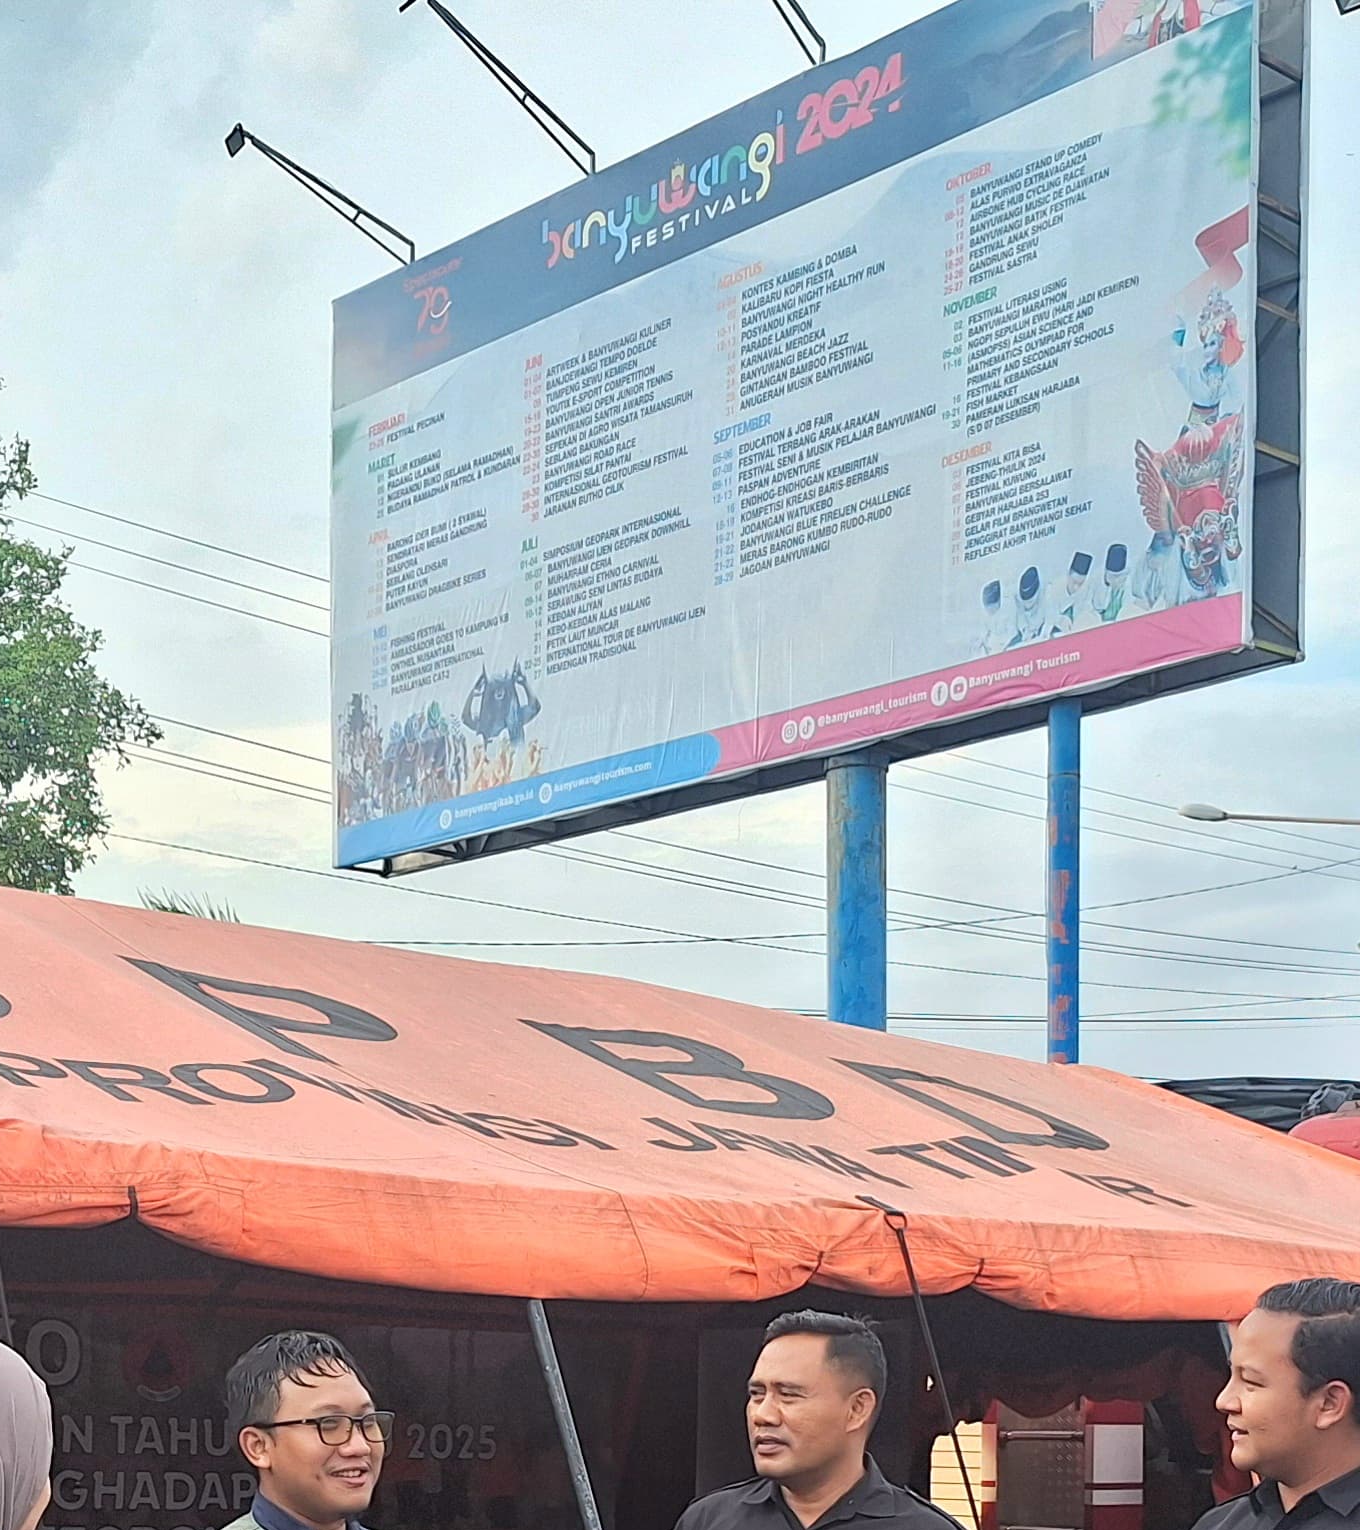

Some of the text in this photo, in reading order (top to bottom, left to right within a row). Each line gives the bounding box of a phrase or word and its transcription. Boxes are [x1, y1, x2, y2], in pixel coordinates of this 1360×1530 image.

[795, 52, 910, 154] 2024
[969, 131, 1102, 199] BANYUWANGI STAND UP COMEDY
[969, 193, 990, 211] ALAS
[1023, 151, 1087, 188] EXTRAVAGANZA
[1006, 191, 1024, 208] HUB
[1025, 175, 1061, 200] CYCLING
[1062, 164, 1085, 184] RACE
[630, 188, 751, 255] FESTIVAL
[969, 167, 1110, 236] BANYUWANGI MUSIC DE DJAWATAN
[969, 189, 1087, 249] BANYUWANGI BATIK FESTIVAL
[968, 235, 1039, 274] GANDRUNG SEWU
[969, 212, 1064, 261] FESTIVAL ANAK SHOLEH
[741, 277, 774, 301] KONTES
[775, 260, 815, 287] KAMBING
[824, 242, 857, 266] DOMBA
[741, 266, 834, 315] KALIBARU KOPI FIESTA
[968, 248, 1037, 286] FESTIVAL SASTRA
[741, 260, 885, 329] BANYUWANGI NIGHT HEALTHY RUN
[943, 285, 997, 317] NOVEMBER
[967, 276, 1067, 326] FESTIVAL LITERASI USING
[967, 289, 1067, 338] BANYUWANGI MARATHON
[740, 317, 813, 356] PARADE LAMPION
[741, 300, 821, 343] POSYANDU KREATIF
[967, 331, 993, 350] NGOPI
[994, 316, 1030, 340] SEPULUH
[1031, 308, 1050, 326] EWU
[1051, 299, 1074, 318] (HARI
[1075, 291, 1095, 309] JADI
[1012, 326, 1037, 346] ASIAN
[1038, 312, 1074, 336] SCIENCE
[1075, 304, 1093, 322] AND
[740, 326, 825, 370] KARNAVAL MERDEKA
[740, 331, 849, 384] BANYUWANGI BEACH JAZZ
[740, 338, 868, 397] GINTANGAN BAMBOO FESTIVAL
[966, 322, 1114, 387] PRIMARY AND SECONDARY SCHOOLS
[967, 320, 1084, 375] MATHEMATICS OLYMPIAD FOR
[739, 350, 873, 411] ANUGERAH MUSIK BANYUWANGI
[966, 356, 1058, 400] FESTIVAL KEBANGSAAN
[966, 384, 1018, 412] FISH MARKET
[713, 411, 771, 445] SEPTEMBER
[738, 428, 785, 456] EDUCATION
[794, 419, 811, 435] JOB
[813, 411, 833, 429] FAIR
[966, 402, 1003, 424] PAMERAN
[738, 459, 775, 483] FESTIVAL
[776, 452, 796, 469] SENI
[806, 439, 833, 459] MUSIK
[835, 424, 874, 449] PELAJAR
[875, 402, 936, 434] BANYUWANGI
[738, 446, 775, 469] FESTIVAL
[777, 431, 816, 455] TERBANG
[740, 495, 833, 537] JODANGAN WATUKEBO
[968, 647, 1080, 690] Banyuwangi Tourism
[648, 1117, 906, 1188] JAWA
[111, 1416, 233, 1457] TAHU
[407, 1423, 498, 1460] 2025
[54, 1472, 259, 1511] GHADAP
